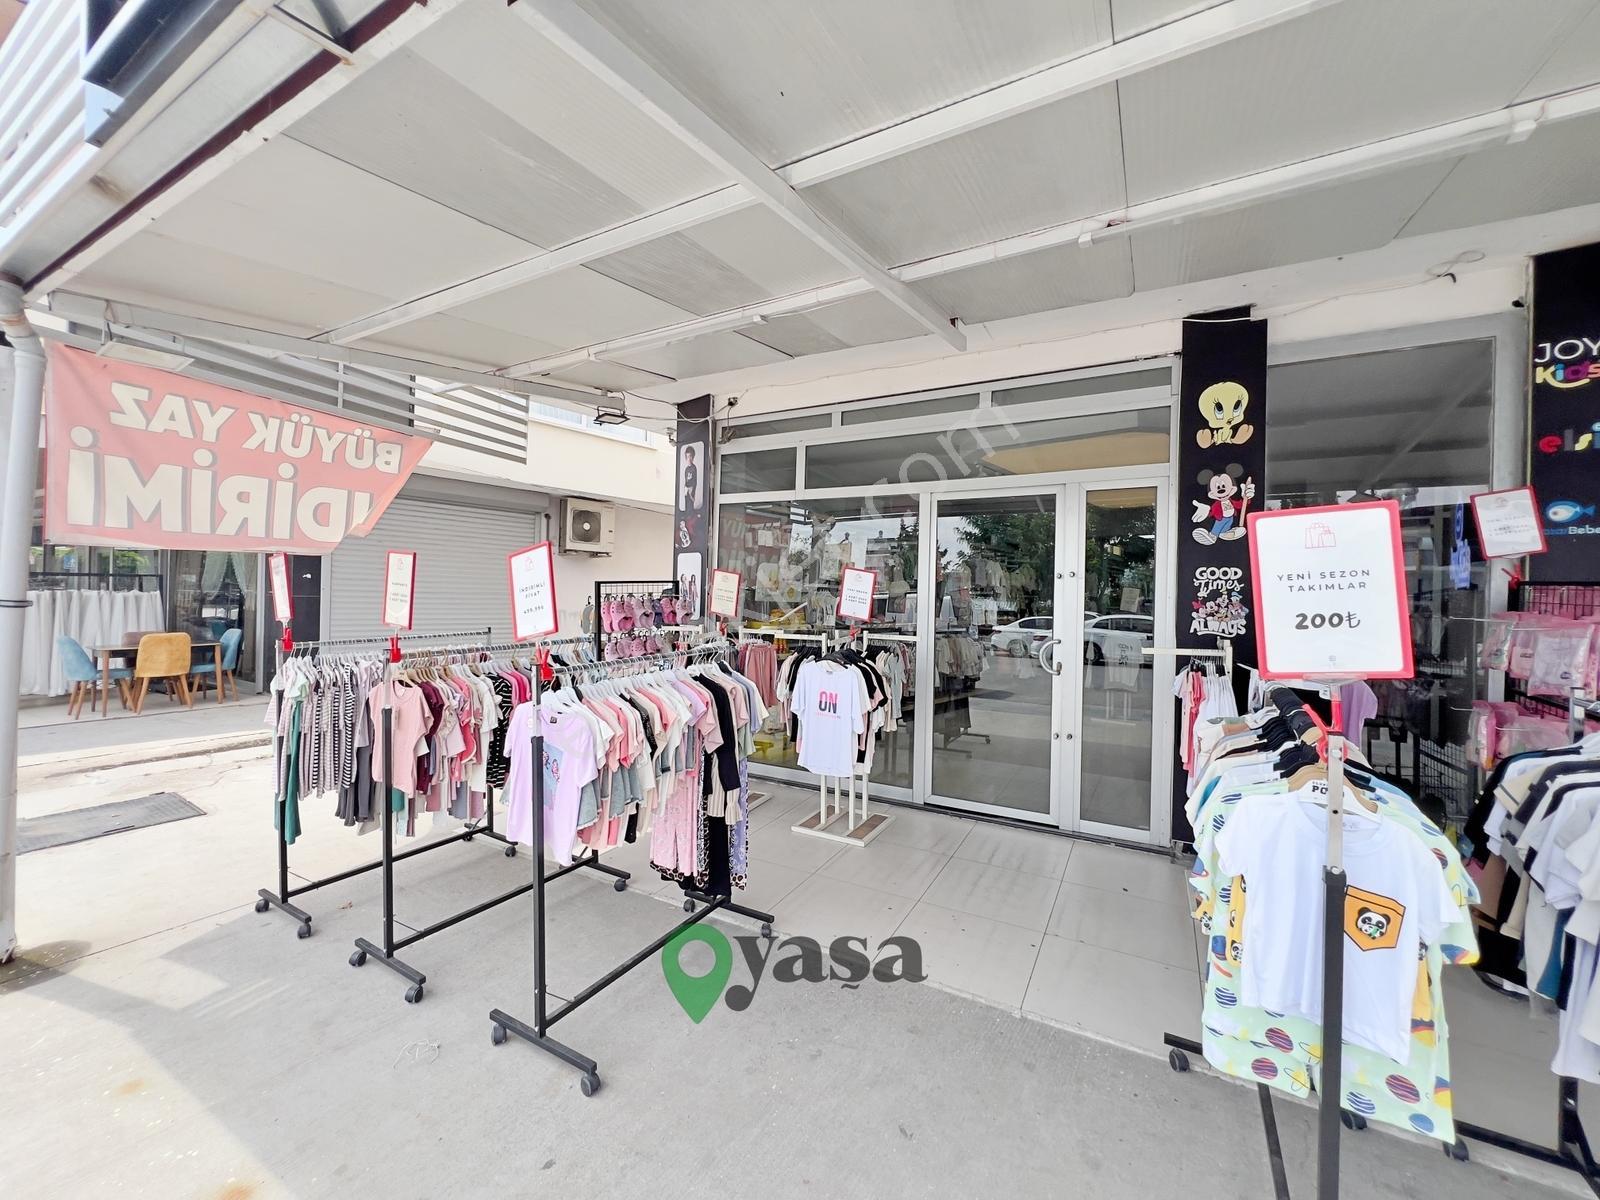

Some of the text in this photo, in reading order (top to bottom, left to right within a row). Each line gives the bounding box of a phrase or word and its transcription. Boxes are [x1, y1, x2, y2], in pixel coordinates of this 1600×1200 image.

[1534, 337, 1600, 363] JOY
[1535, 360, 1600, 388] Kids
[1195, 566, 1243, 580] GOOD
[1277, 569, 1370, 581] YENİ SEZON
[1193, 578, 1245, 598] Times
[1288, 581, 1367, 592] TAKIMLAR
[1189, 616, 1247, 638] ALWAYS
[818, 690, 838, 714] ON
